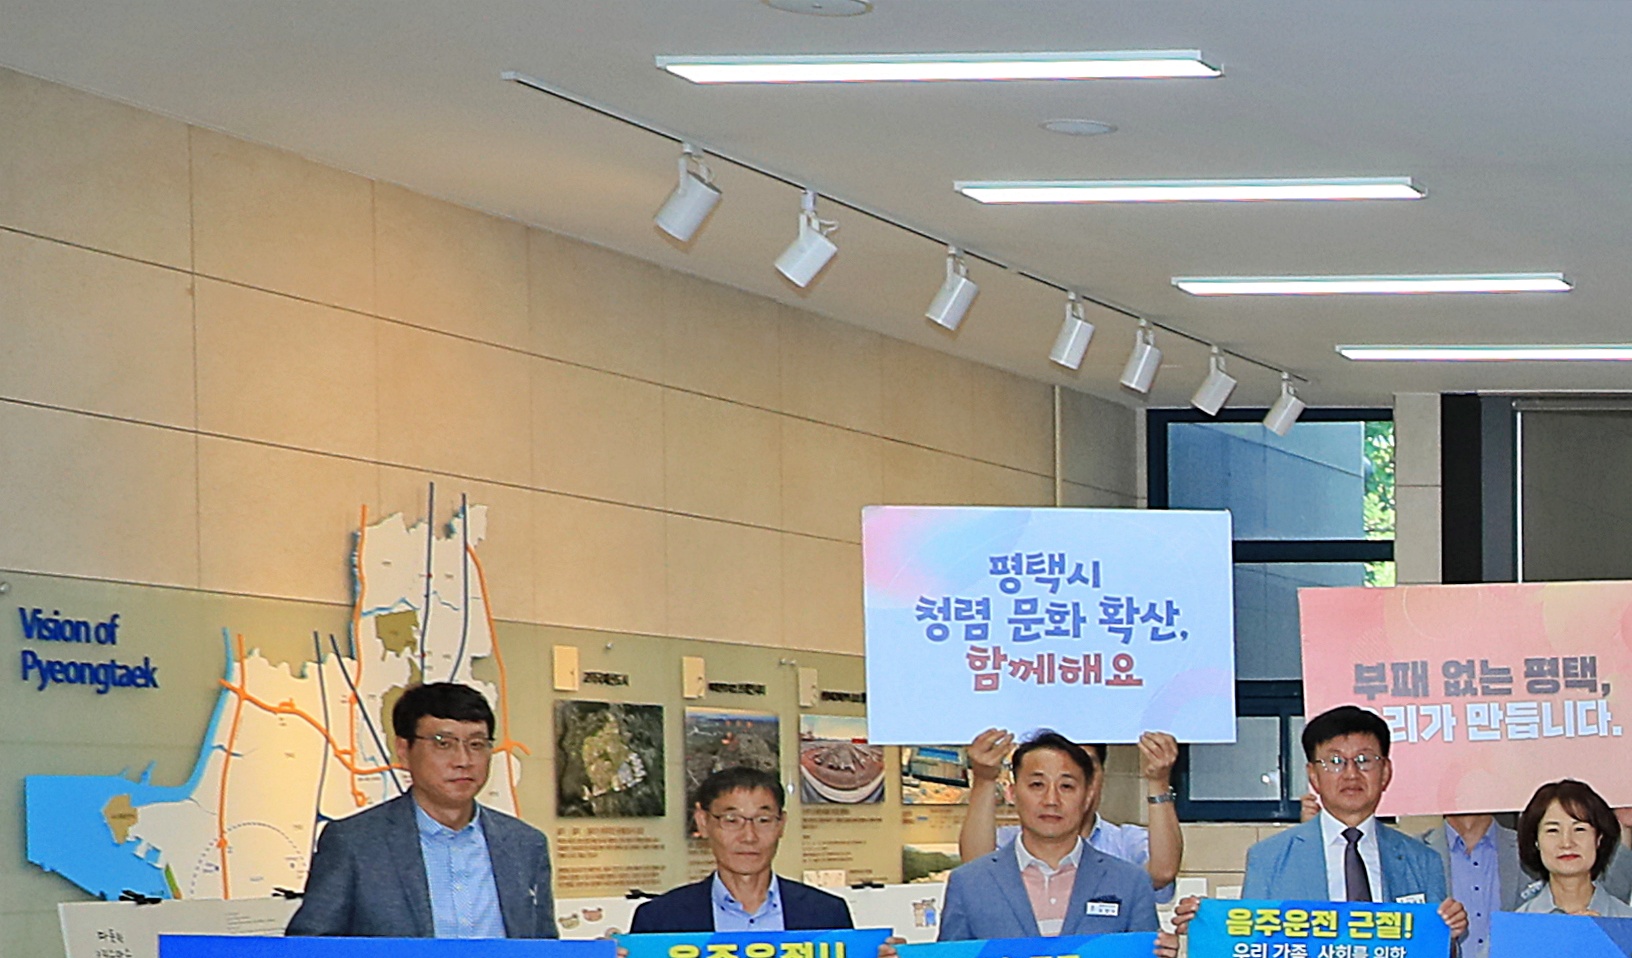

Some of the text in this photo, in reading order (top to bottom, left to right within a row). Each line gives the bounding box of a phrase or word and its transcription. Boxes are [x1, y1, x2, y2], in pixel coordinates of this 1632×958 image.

[989, 552, 1102, 594] 평택시
[19, 607, 120, 645] Vision of
[915, 595, 1188, 644] 청렴 문화 확산,
[21, 650, 159, 694] Pyeongtaek
[966, 646, 1143, 692] 함께해요
[1353, 656, 1611, 699] 부패 없는 평택,
[1366, 699, 1623, 743] 리가 만듭니다.
[1226, 908, 1413, 939] 음주운전 근절!
